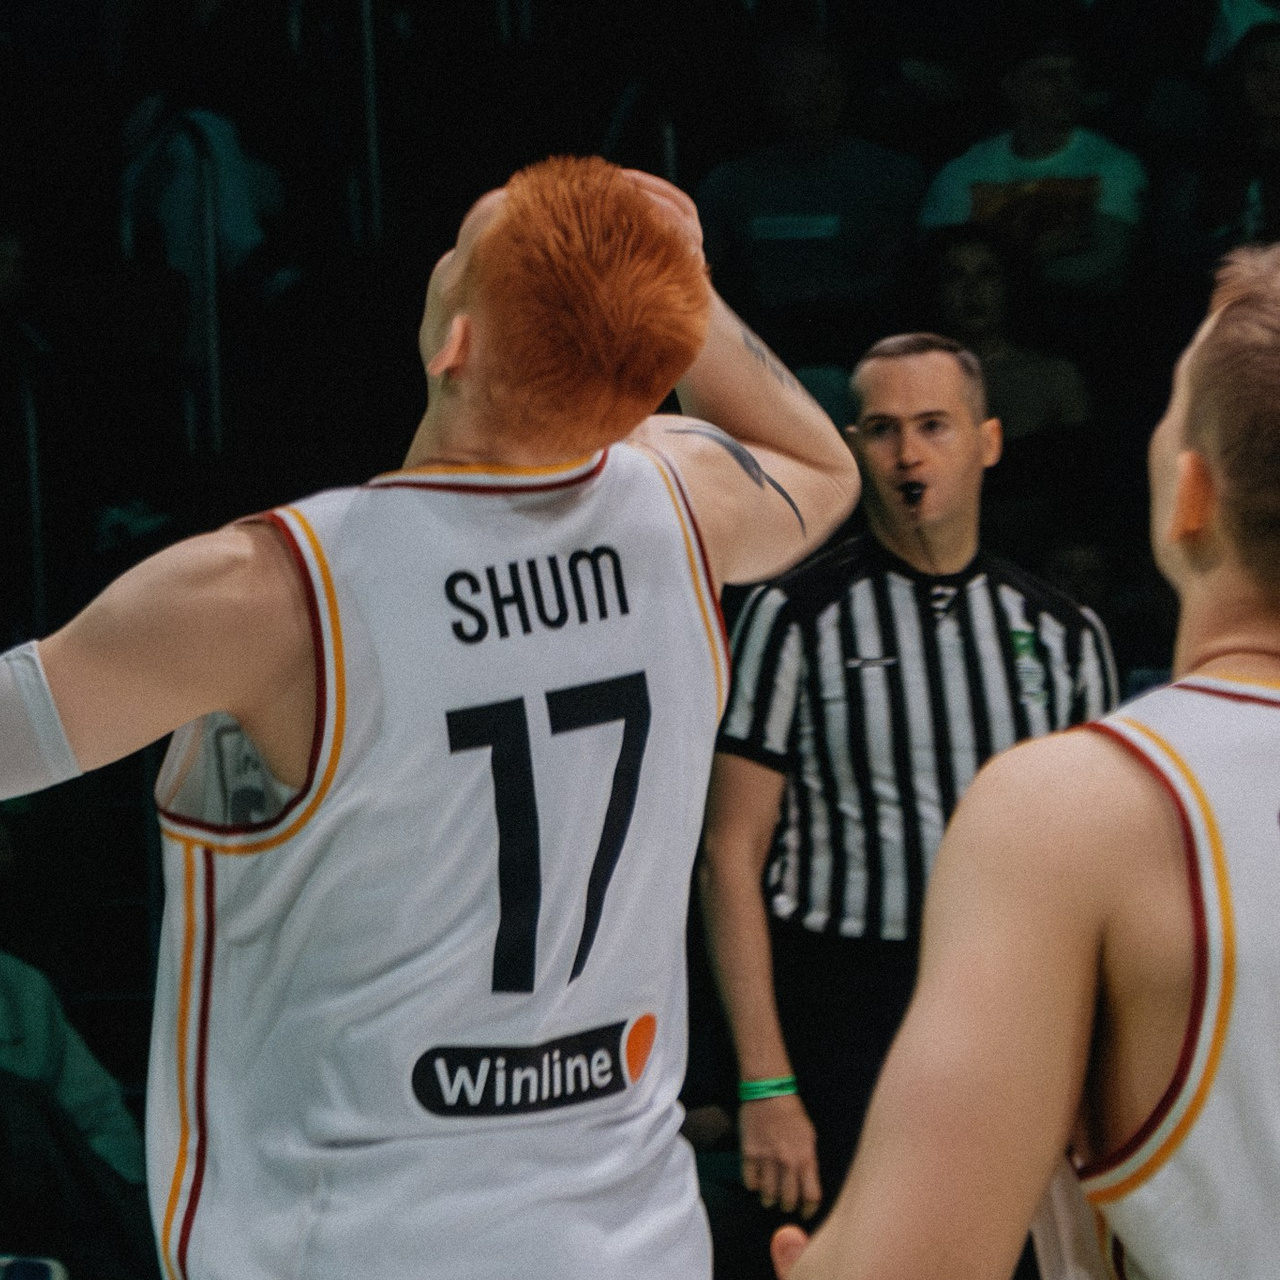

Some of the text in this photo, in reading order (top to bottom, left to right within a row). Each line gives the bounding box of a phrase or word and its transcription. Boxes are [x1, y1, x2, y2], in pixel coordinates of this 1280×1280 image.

[445, 545, 629, 644] SHUM
[445, 669, 651, 995] 17
[433, 1047, 614, 1107] Winline
